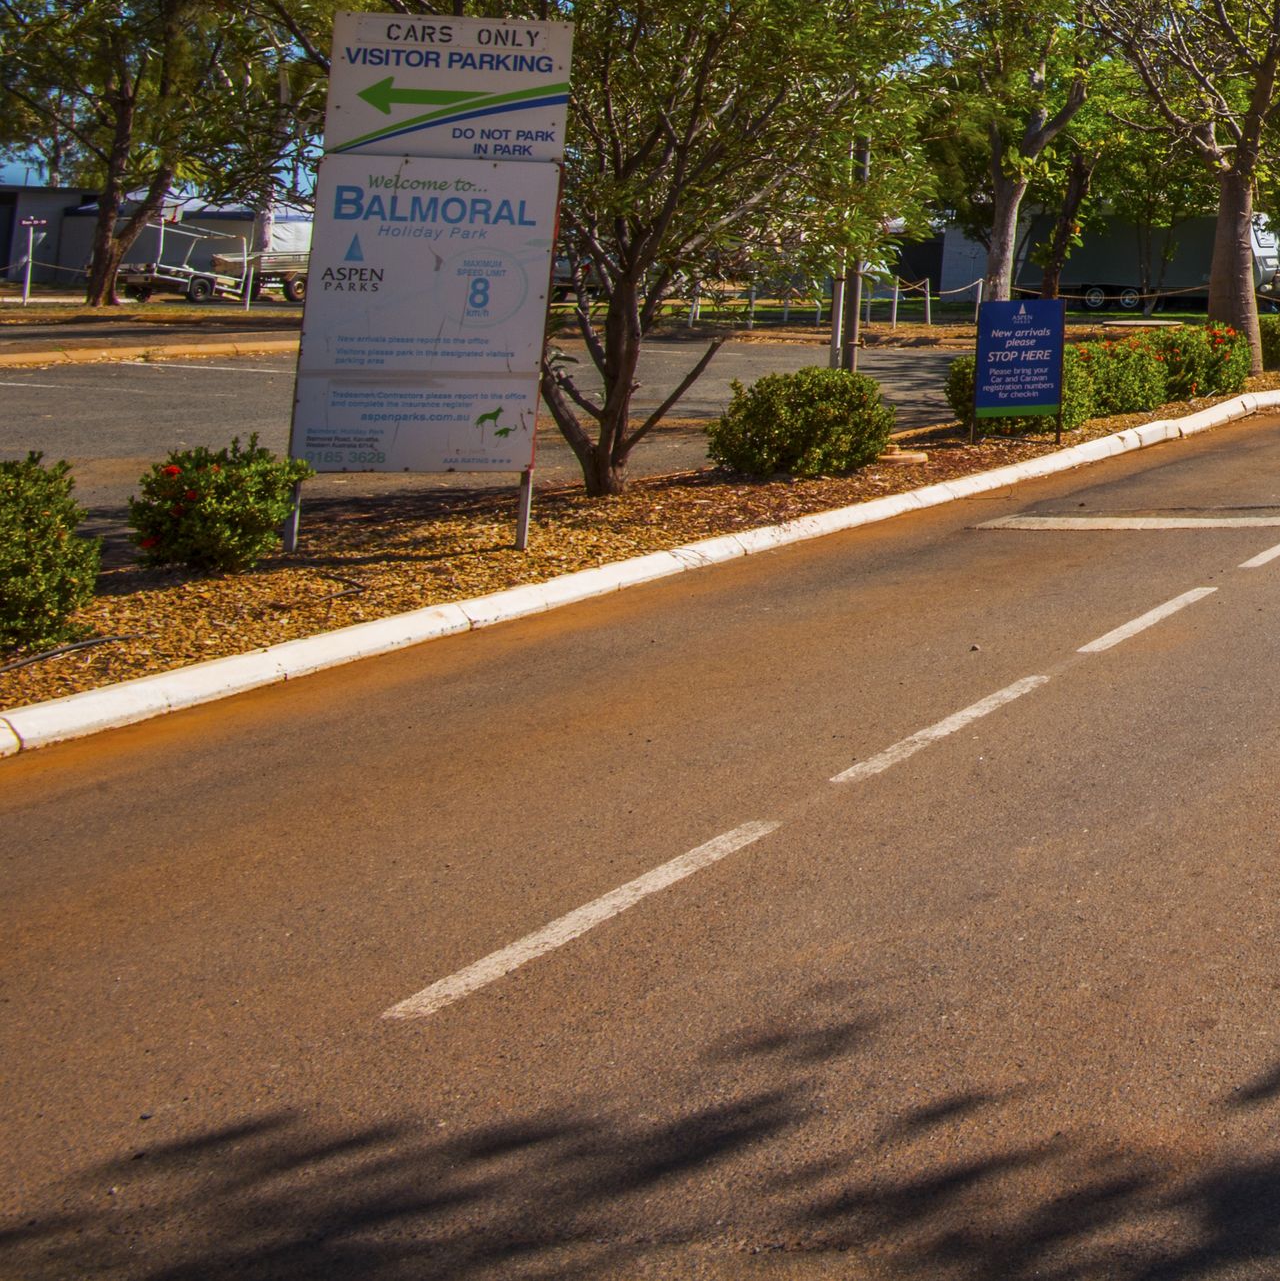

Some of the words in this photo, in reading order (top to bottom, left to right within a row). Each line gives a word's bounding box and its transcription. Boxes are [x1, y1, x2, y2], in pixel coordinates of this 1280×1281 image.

[386, 23, 454, 44] CARS
[477, 28, 540, 48] ONLY
[345, 47, 440, 68] VISITOR
[448, 52, 553, 73] PARKING
[452, 127, 475, 140] DO
[480, 129, 510, 141] NOT
[516, 130, 555, 142] PARK
[473, 143, 487, 155] IN
[493, 144, 533, 156] PARK
[369, 174, 452, 191] Welcome
[333, 185, 536, 226] BALMORAL
[378, 224, 443, 240] Holiday
[450, 227, 488, 240] Park
[463, 259, 502, 268] MAXIMUM
[321, 267, 384, 282] ASPEN
[456, 268, 483, 277] SPEED
[486, 269, 507, 277] LIMIT
[323, 282, 380, 292] PARKS
[469, 277, 489, 308] 8
[466, 309, 489, 317] km/h
[991, 329, 1012, 338] New
[1015, 327, 1051, 337] arrivals
[1005, 338, 1036, 348] please
[987, 351, 1018, 362] STOP
[1020, 349, 1052, 361] HERE
[1013, 367, 1032, 375] bring
[1033, 367, 1048, 375] your
[1020, 374, 1048, 382] Caravan
[982, 383, 1023, 392] registration
[998, 391, 1008, 399] for
[360, 413, 470, 423] aspenparks.com.au
[305, 451, 343, 463] 9185
[348, 451, 386, 463] 3628
